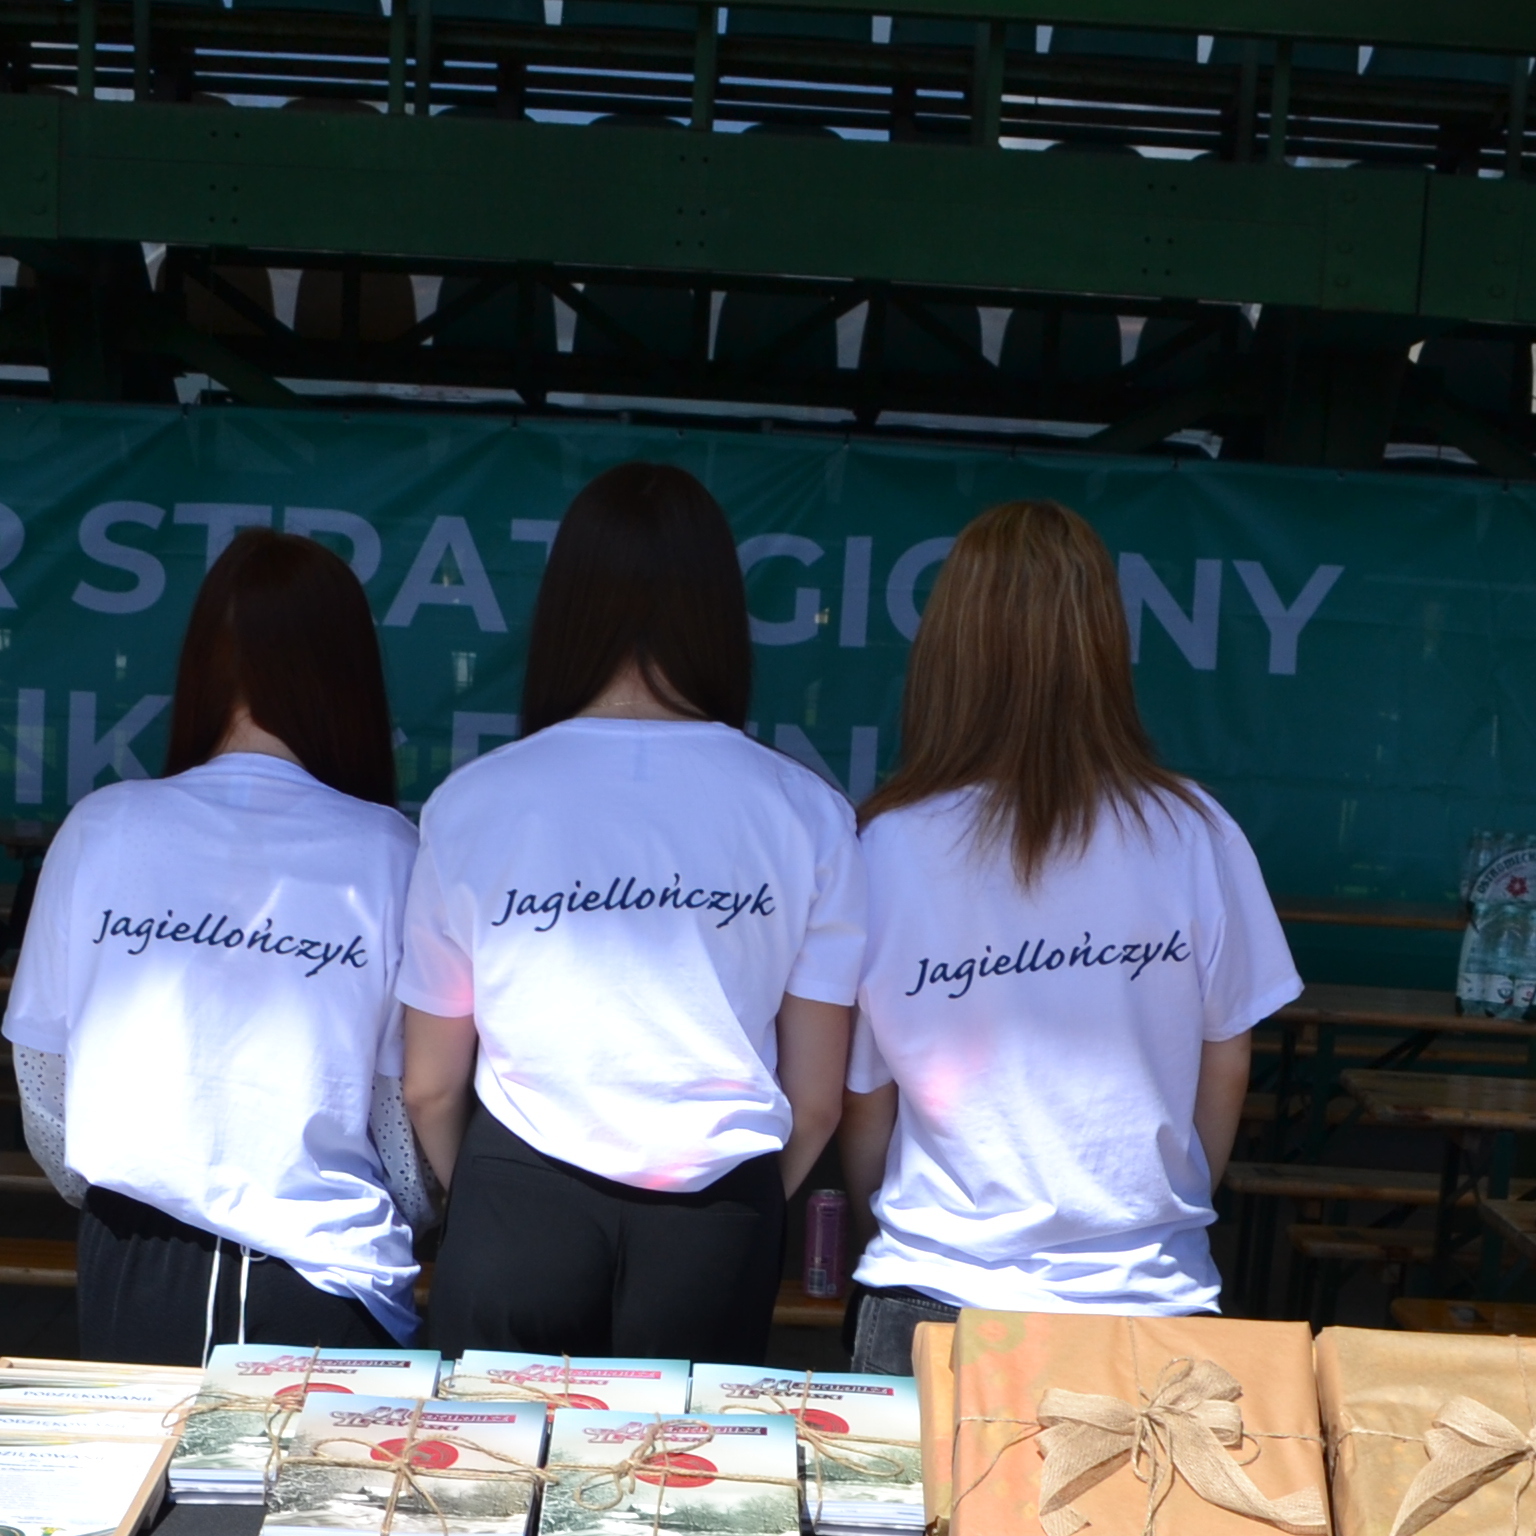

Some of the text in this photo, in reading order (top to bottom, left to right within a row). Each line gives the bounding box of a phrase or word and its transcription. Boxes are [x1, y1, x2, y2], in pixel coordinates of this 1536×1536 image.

[492, 874, 776, 930] Jagiellończyk
[93, 904, 369, 979] Jagiellończyk
[906, 930, 1192, 998] Jagiellończyk
